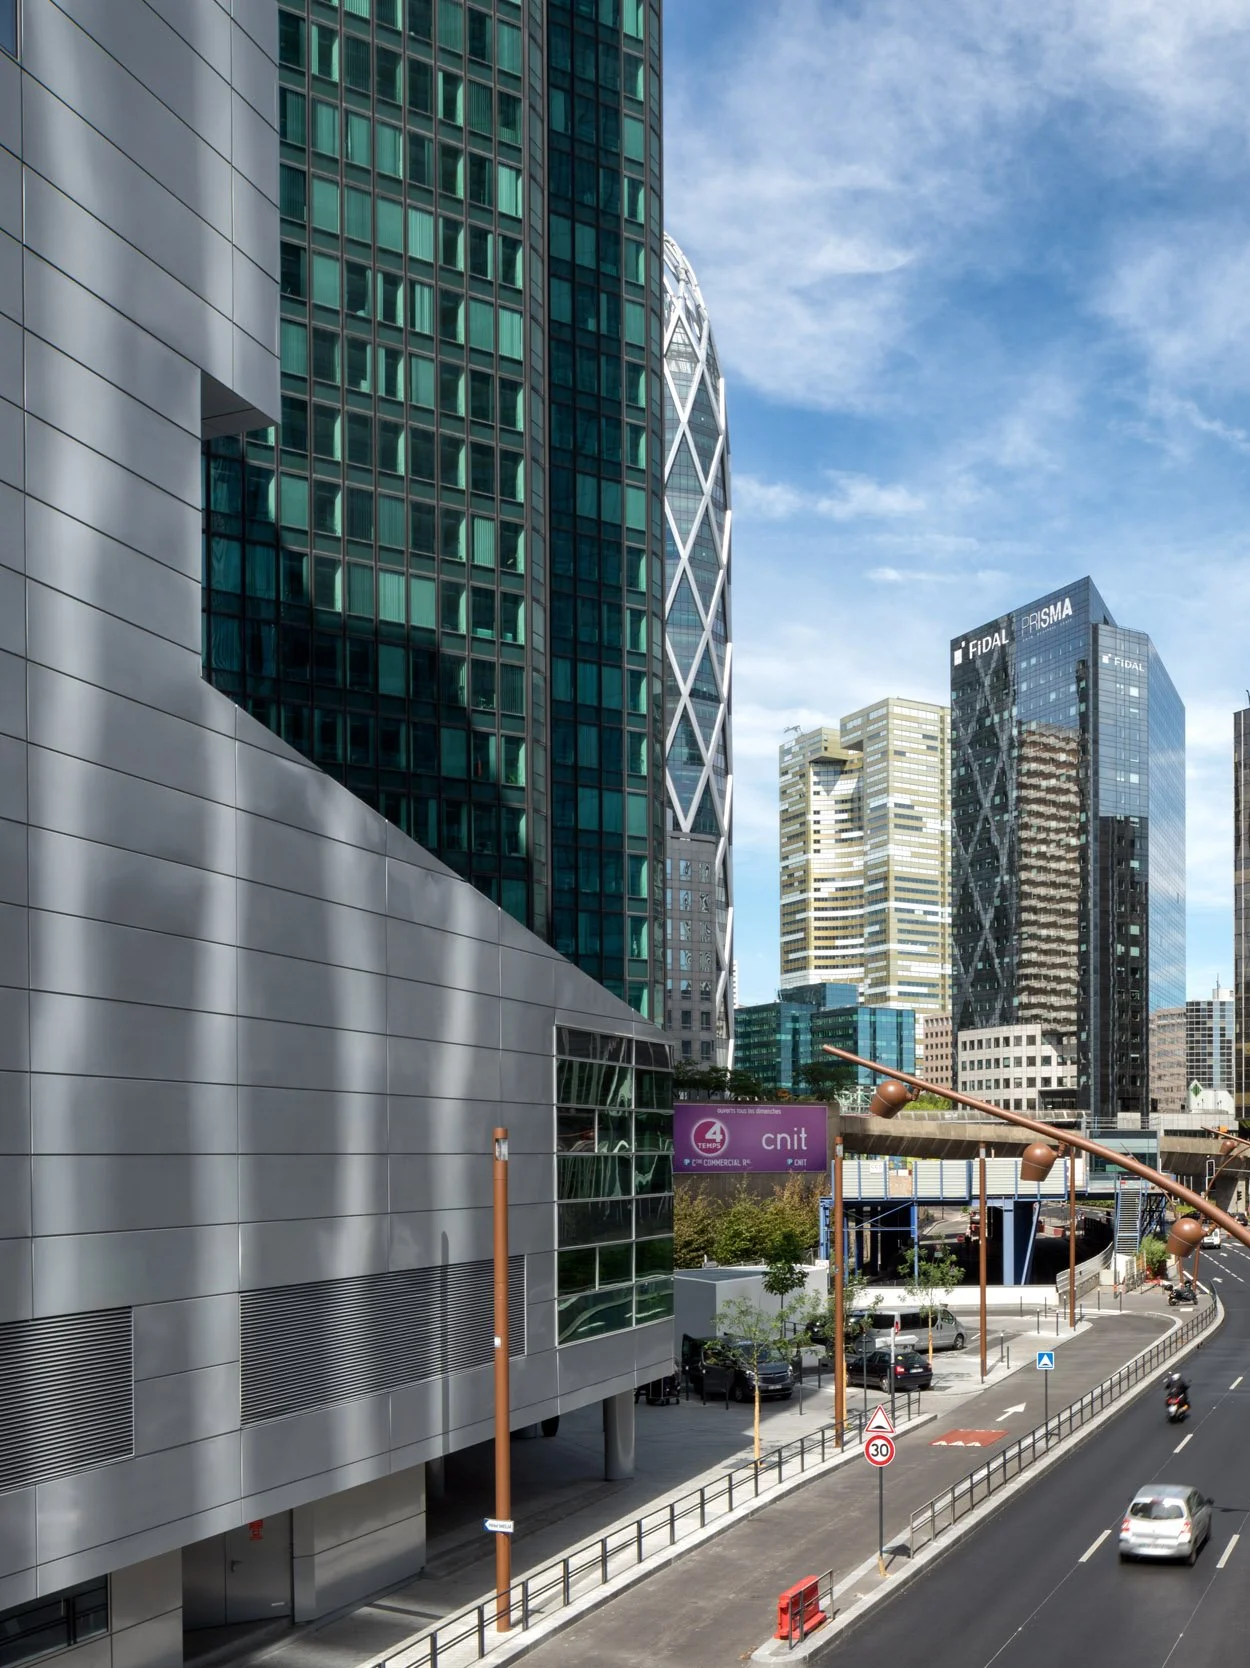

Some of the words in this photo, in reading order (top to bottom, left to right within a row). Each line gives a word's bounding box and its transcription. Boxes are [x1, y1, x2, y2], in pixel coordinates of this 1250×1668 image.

[1021, 597, 1073, 637] PRISMA
[705, 1122, 723, 1143] 4
[762, 1127, 807, 1150] cnit
[703, 1159, 741, 1167] COMMERCIAL
[794, 1158, 807, 1166] CNIT
[871, 1443, 889, 1457] 30
